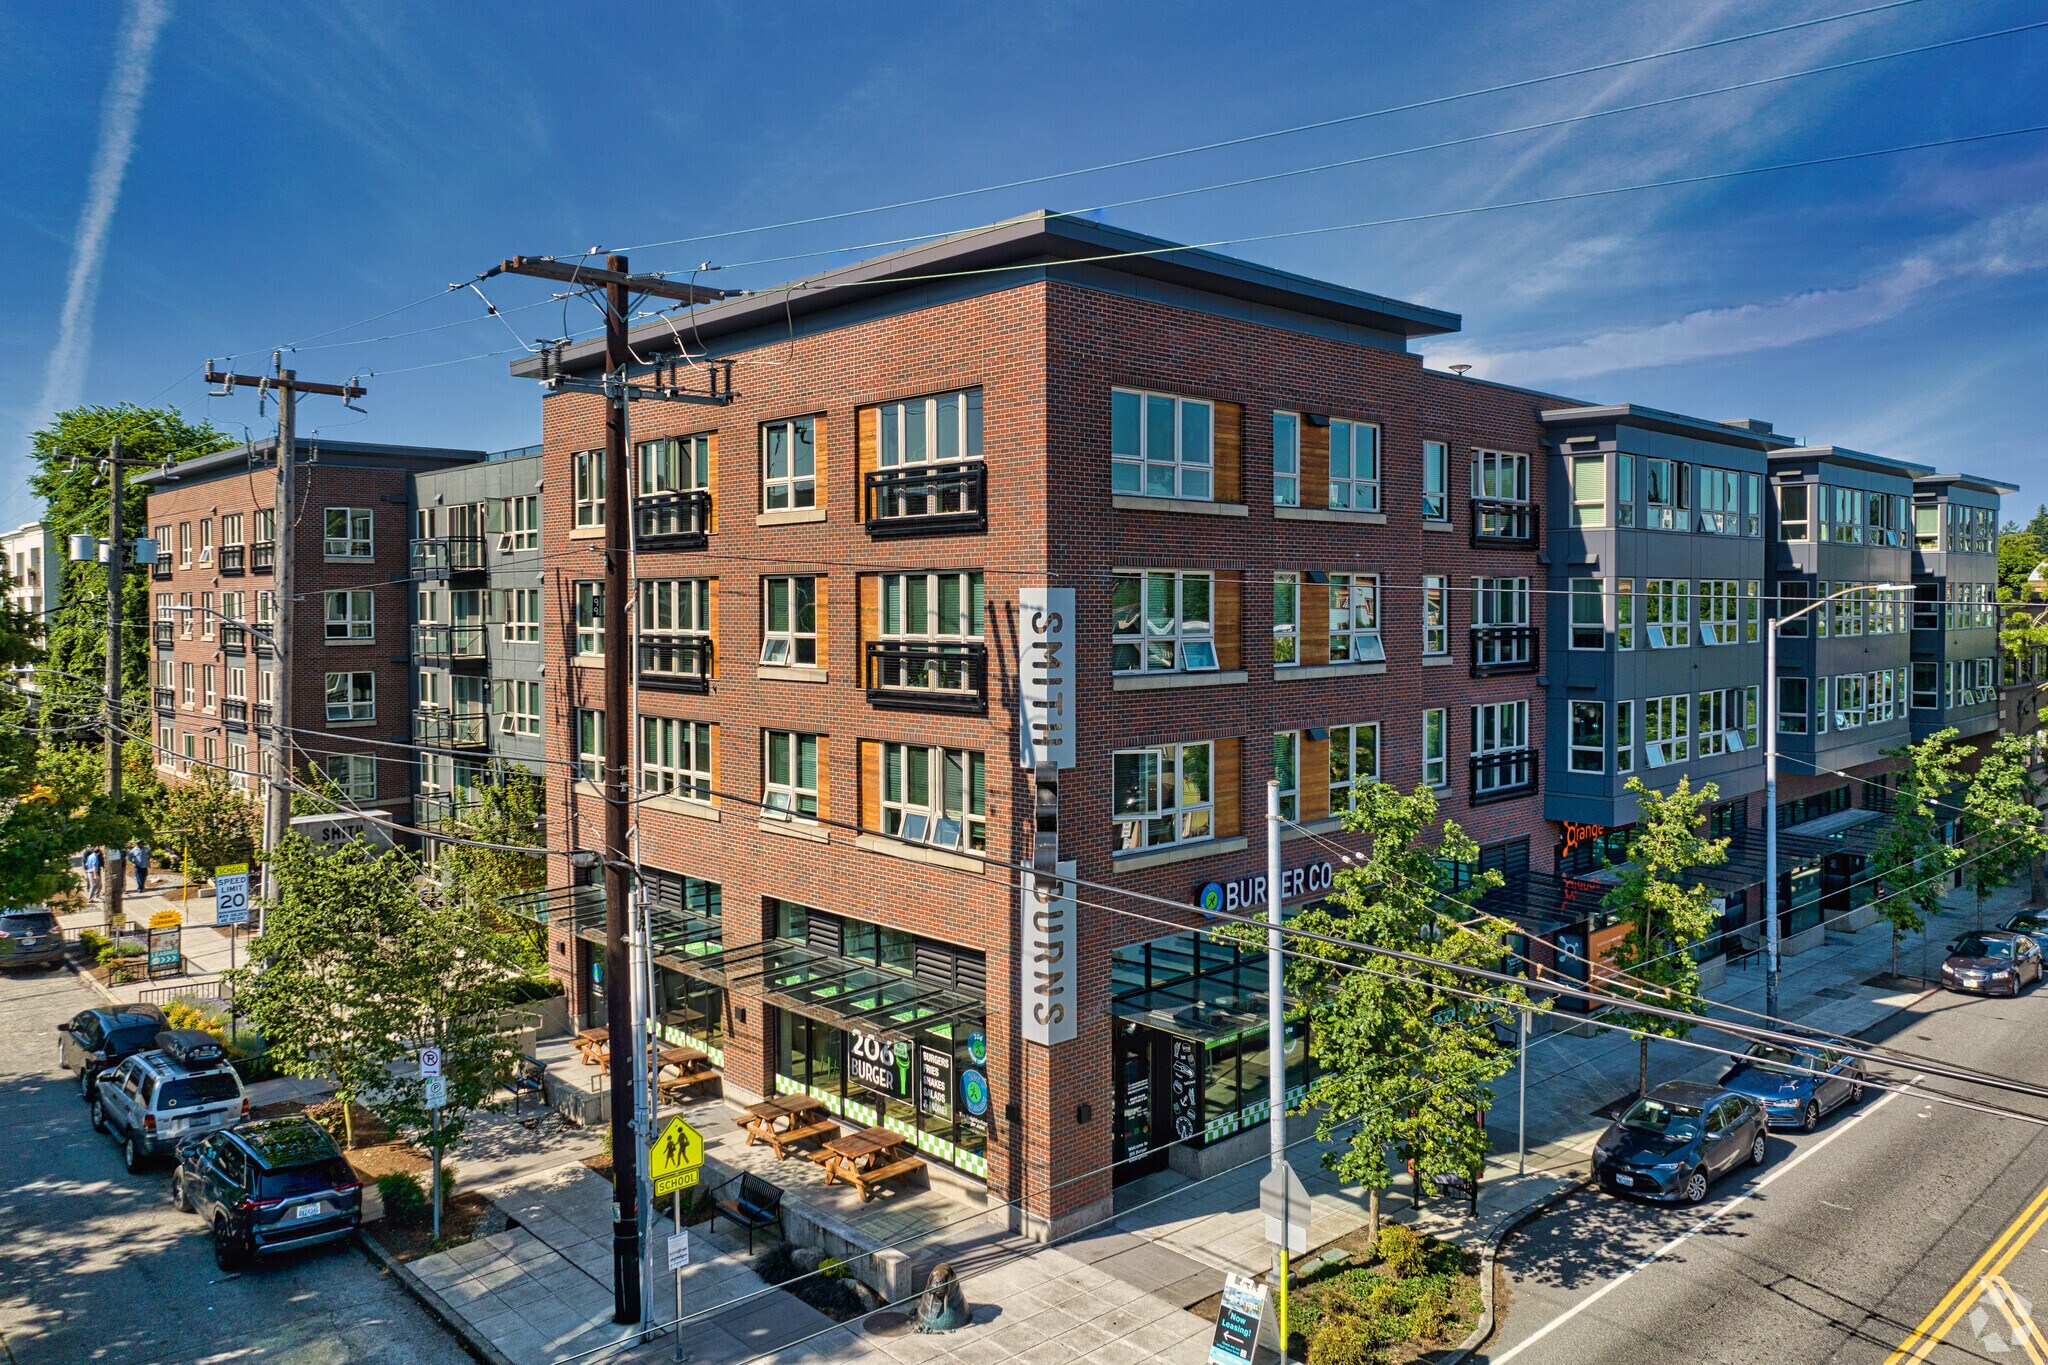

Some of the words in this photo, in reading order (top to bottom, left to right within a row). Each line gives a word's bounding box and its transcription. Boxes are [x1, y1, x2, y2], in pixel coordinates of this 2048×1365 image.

[1031, 611, 1063, 746] SMITH
[218, 865, 245, 874] SCHOOL
[218, 876, 247, 886] SPEED
[221, 884, 244, 894] LIMIT
[1226, 867, 1305, 912] BURER
[220, 893, 246, 909] 20
[151, 949, 178, 958] LEASING
[1033, 880, 1065, 1026] BURNS
[851, 1028, 895, 1067] 206
[922, 1051, 950, 1069] BURGERS
[851, 1057, 894, 1090] BURGER
[923, 1063, 940, 1077] FRIES
[923, 1075, 946, 1092] SHAKES
[923, 1087, 946, 1103] SALADS
[659, 1173, 697, 1192] SCHOOL
[1230, 1312, 1247, 1325] Now
[1221, 1318, 1252, 1338] Leasing!
